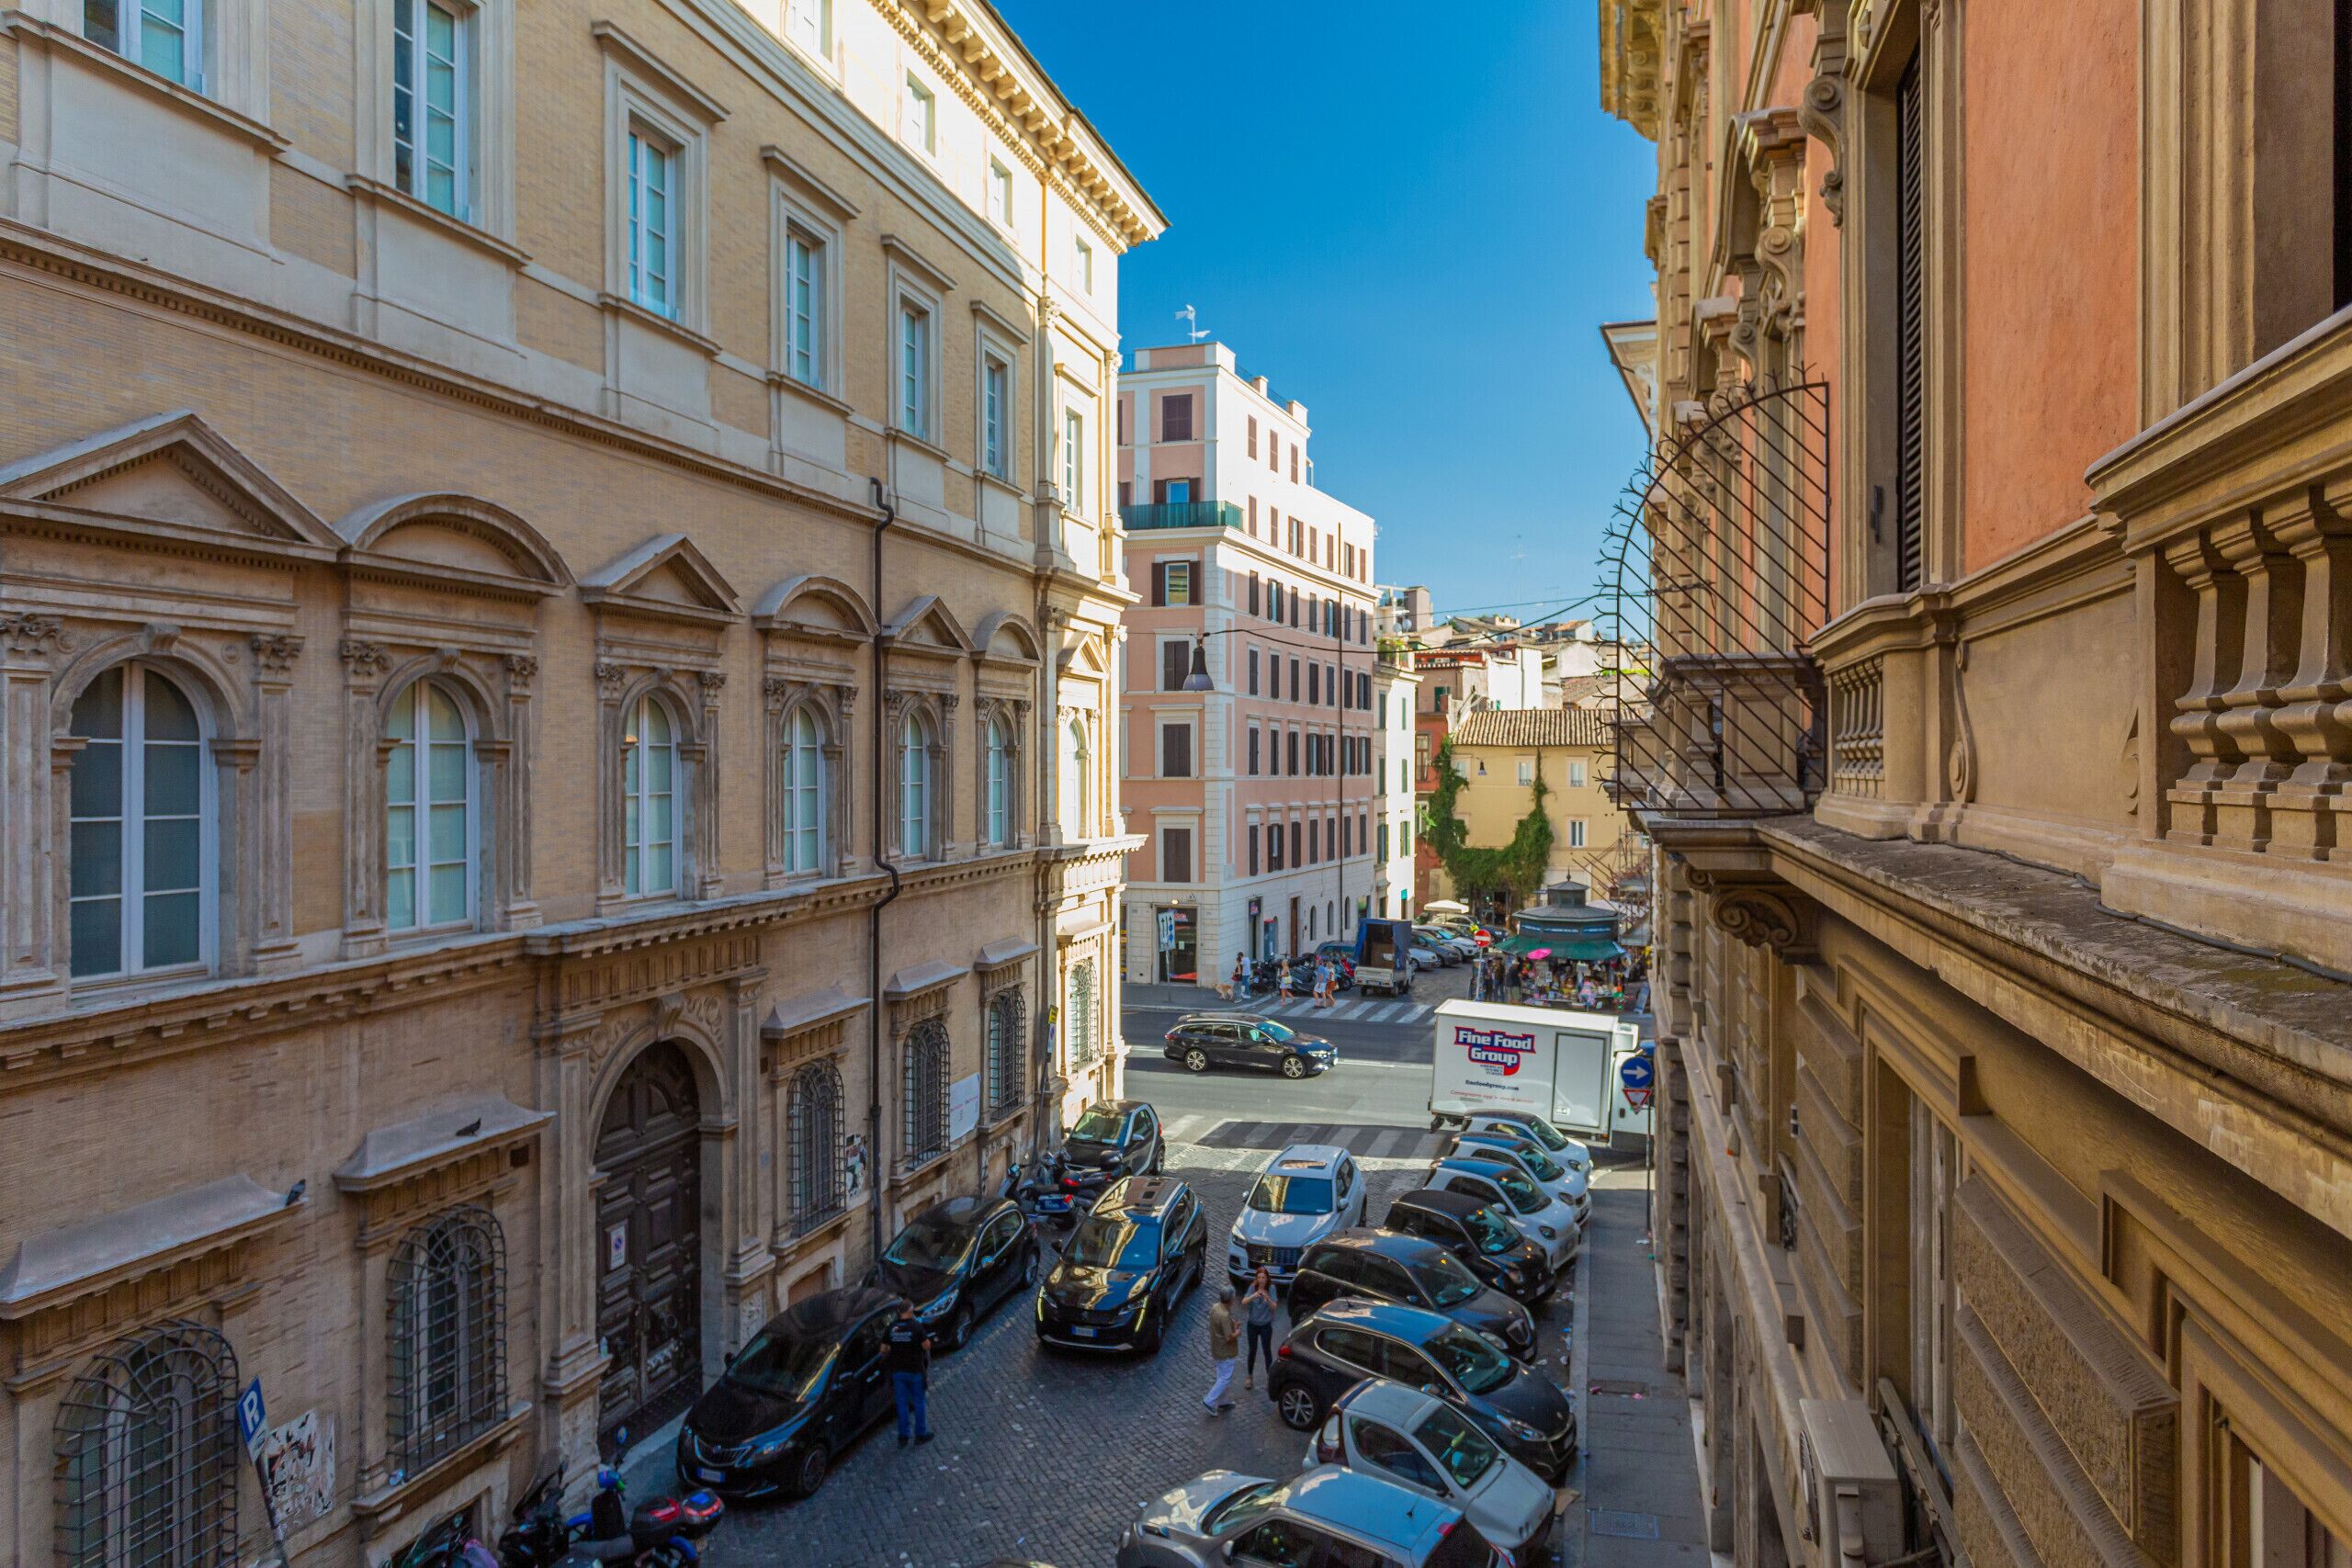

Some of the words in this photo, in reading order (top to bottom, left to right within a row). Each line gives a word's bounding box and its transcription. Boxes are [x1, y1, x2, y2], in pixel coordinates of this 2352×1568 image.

[1458, 1030, 1491, 1045] Fine
[1494, 1034, 1532, 1050] Food
[1471, 1047, 1518, 1066] Group
